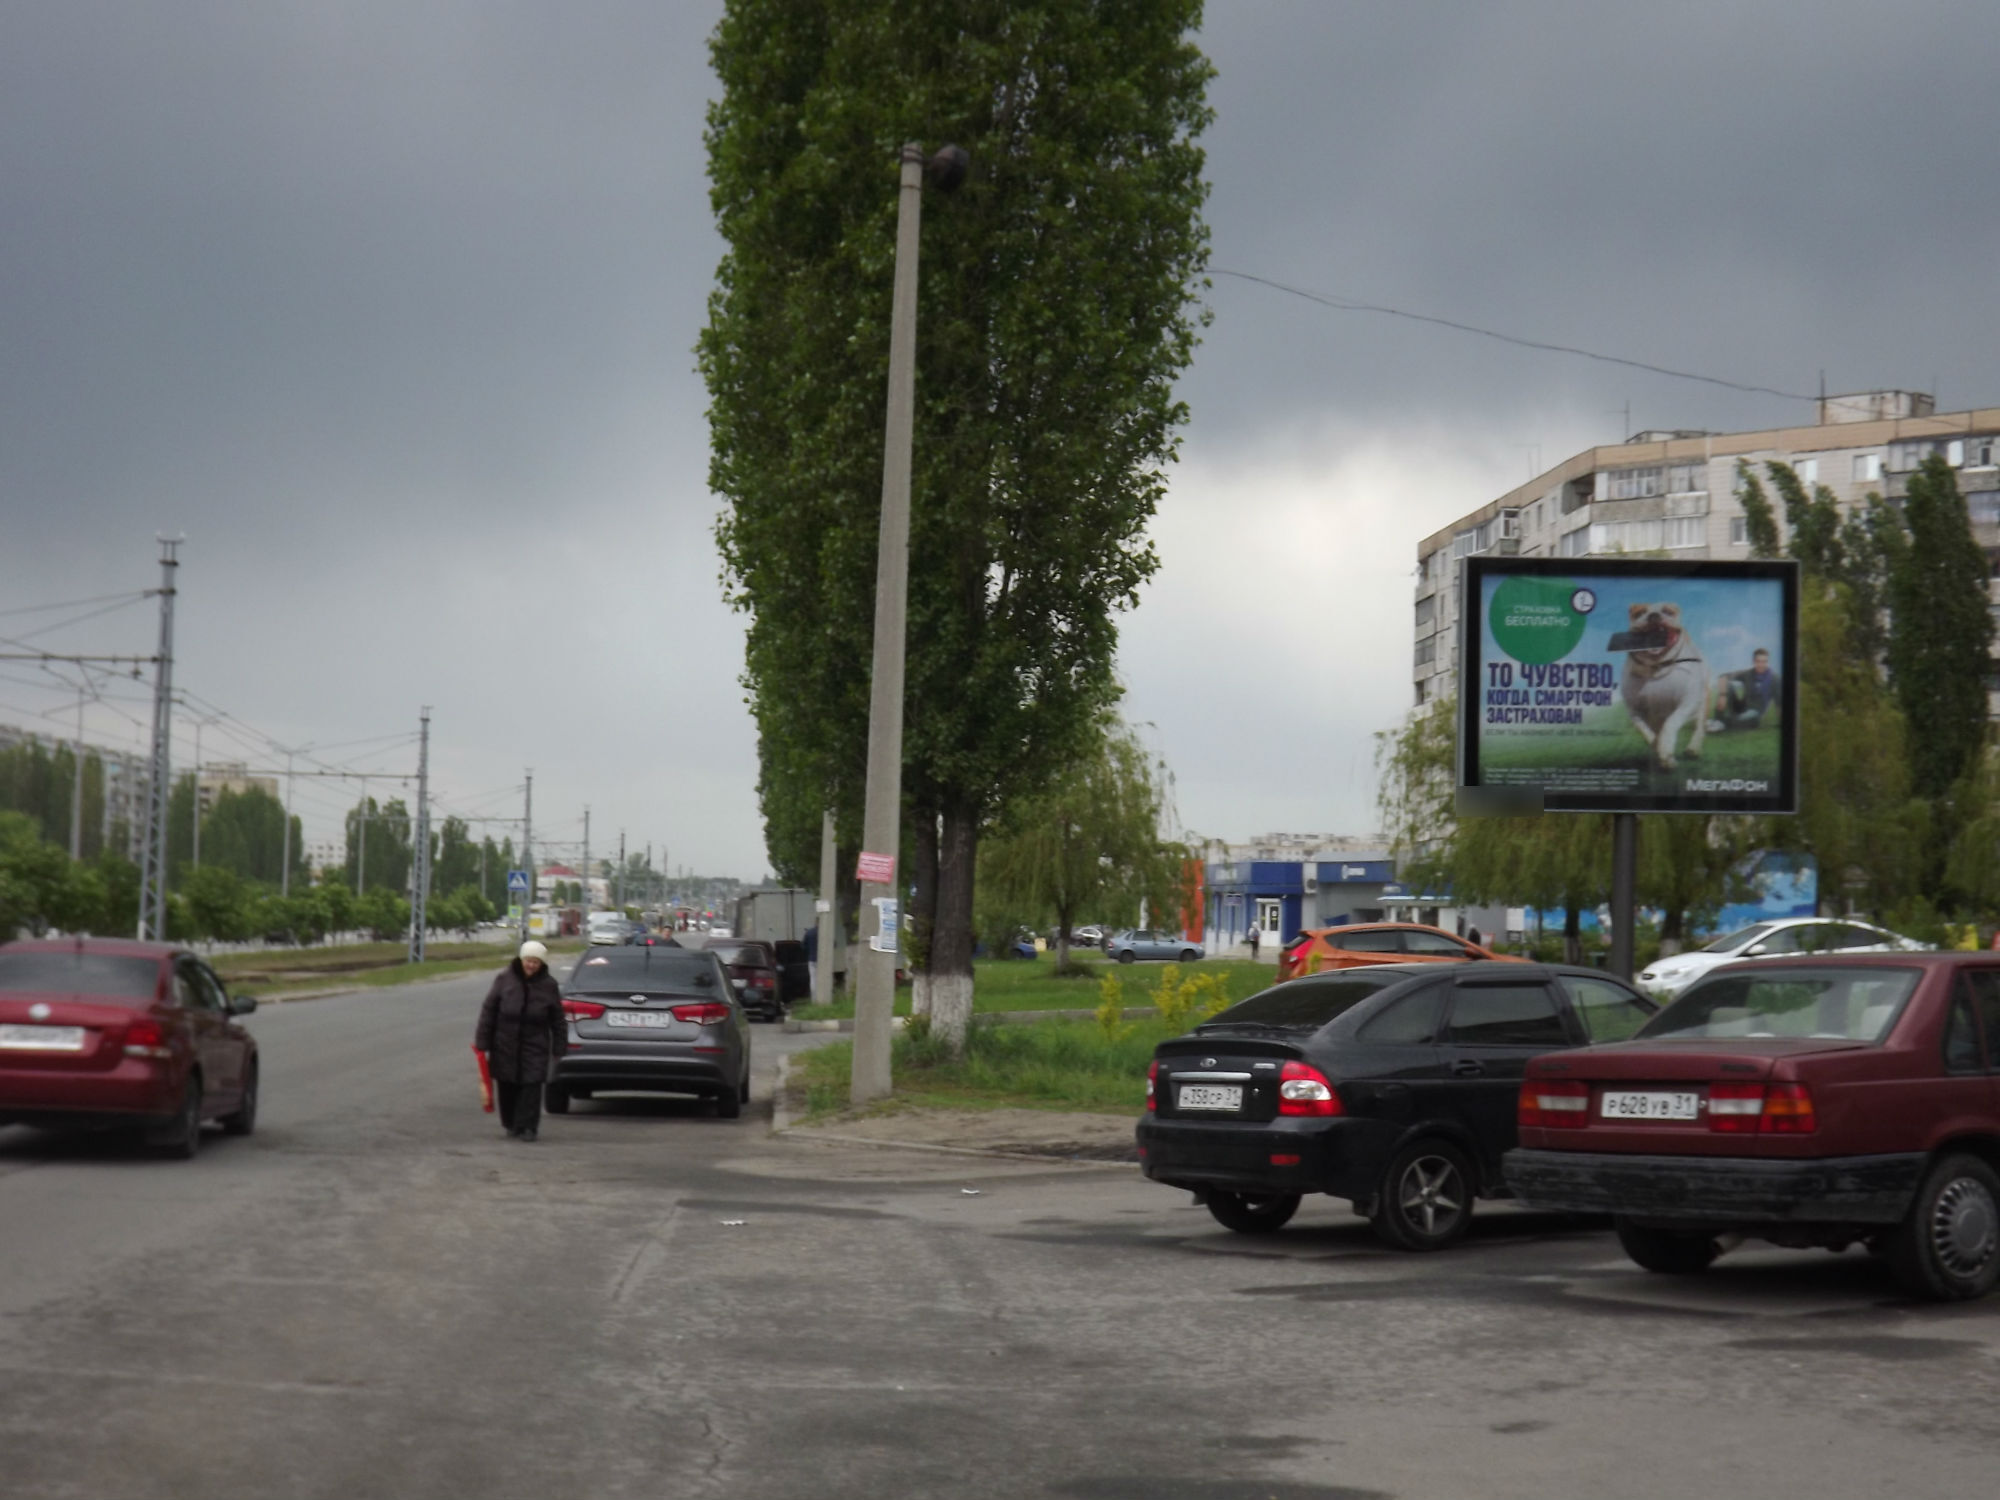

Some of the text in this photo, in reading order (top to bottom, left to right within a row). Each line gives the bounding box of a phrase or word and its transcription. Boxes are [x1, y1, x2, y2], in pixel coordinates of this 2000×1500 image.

[1505, 616, 1571, 626] БЕСПЛАТНО
[1487, 662, 1618, 690] ТО ЧУВСТВО,
[1487, 689, 1612, 706] КОГДА СМАРТФОН
[1487, 707, 1582, 724] ЗАСТРАХОВАН
